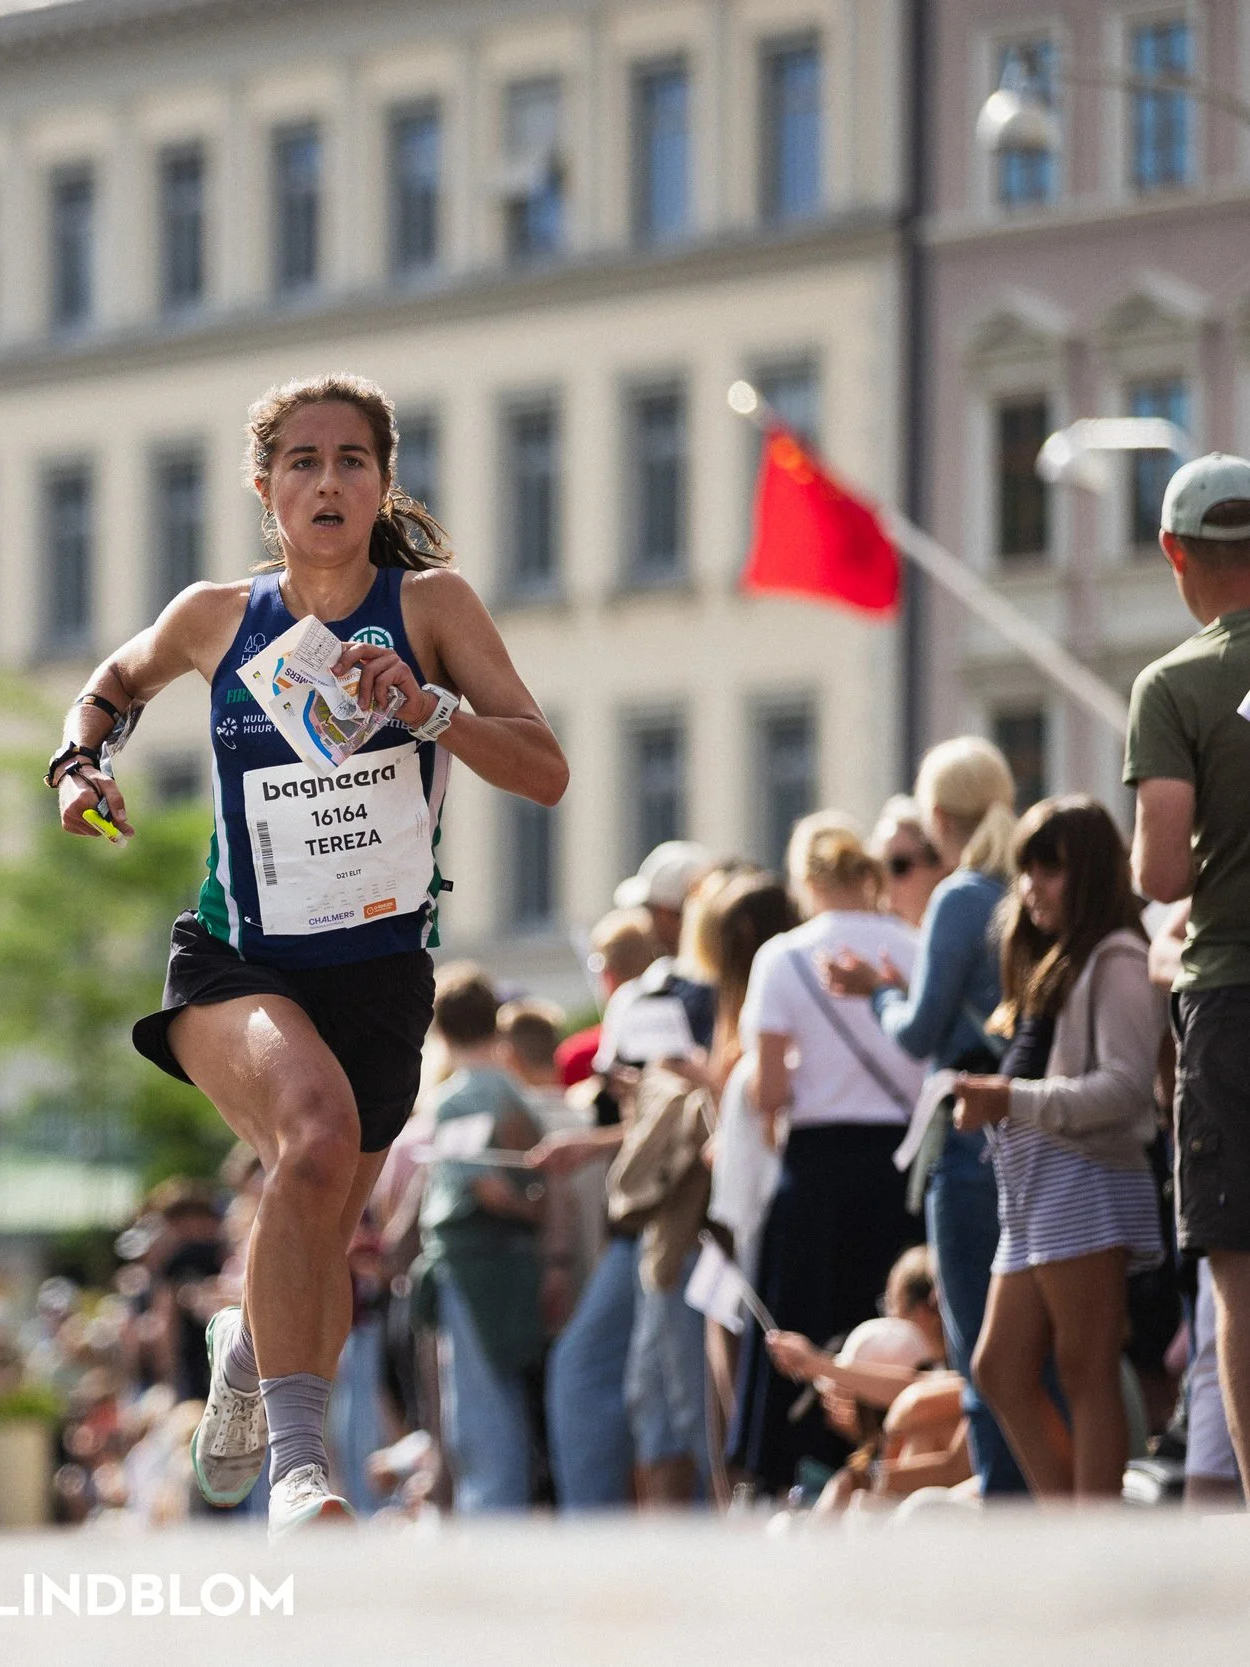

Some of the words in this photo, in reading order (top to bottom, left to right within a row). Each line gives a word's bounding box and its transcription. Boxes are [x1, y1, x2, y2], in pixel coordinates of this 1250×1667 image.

[263, 764, 396, 801] bagheera
[311, 803, 368, 827] 16164
[305, 829, 382, 856] TEREZA
[336, 872, 349, 880] D21
[308, 910, 355, 926] CHALMERS
